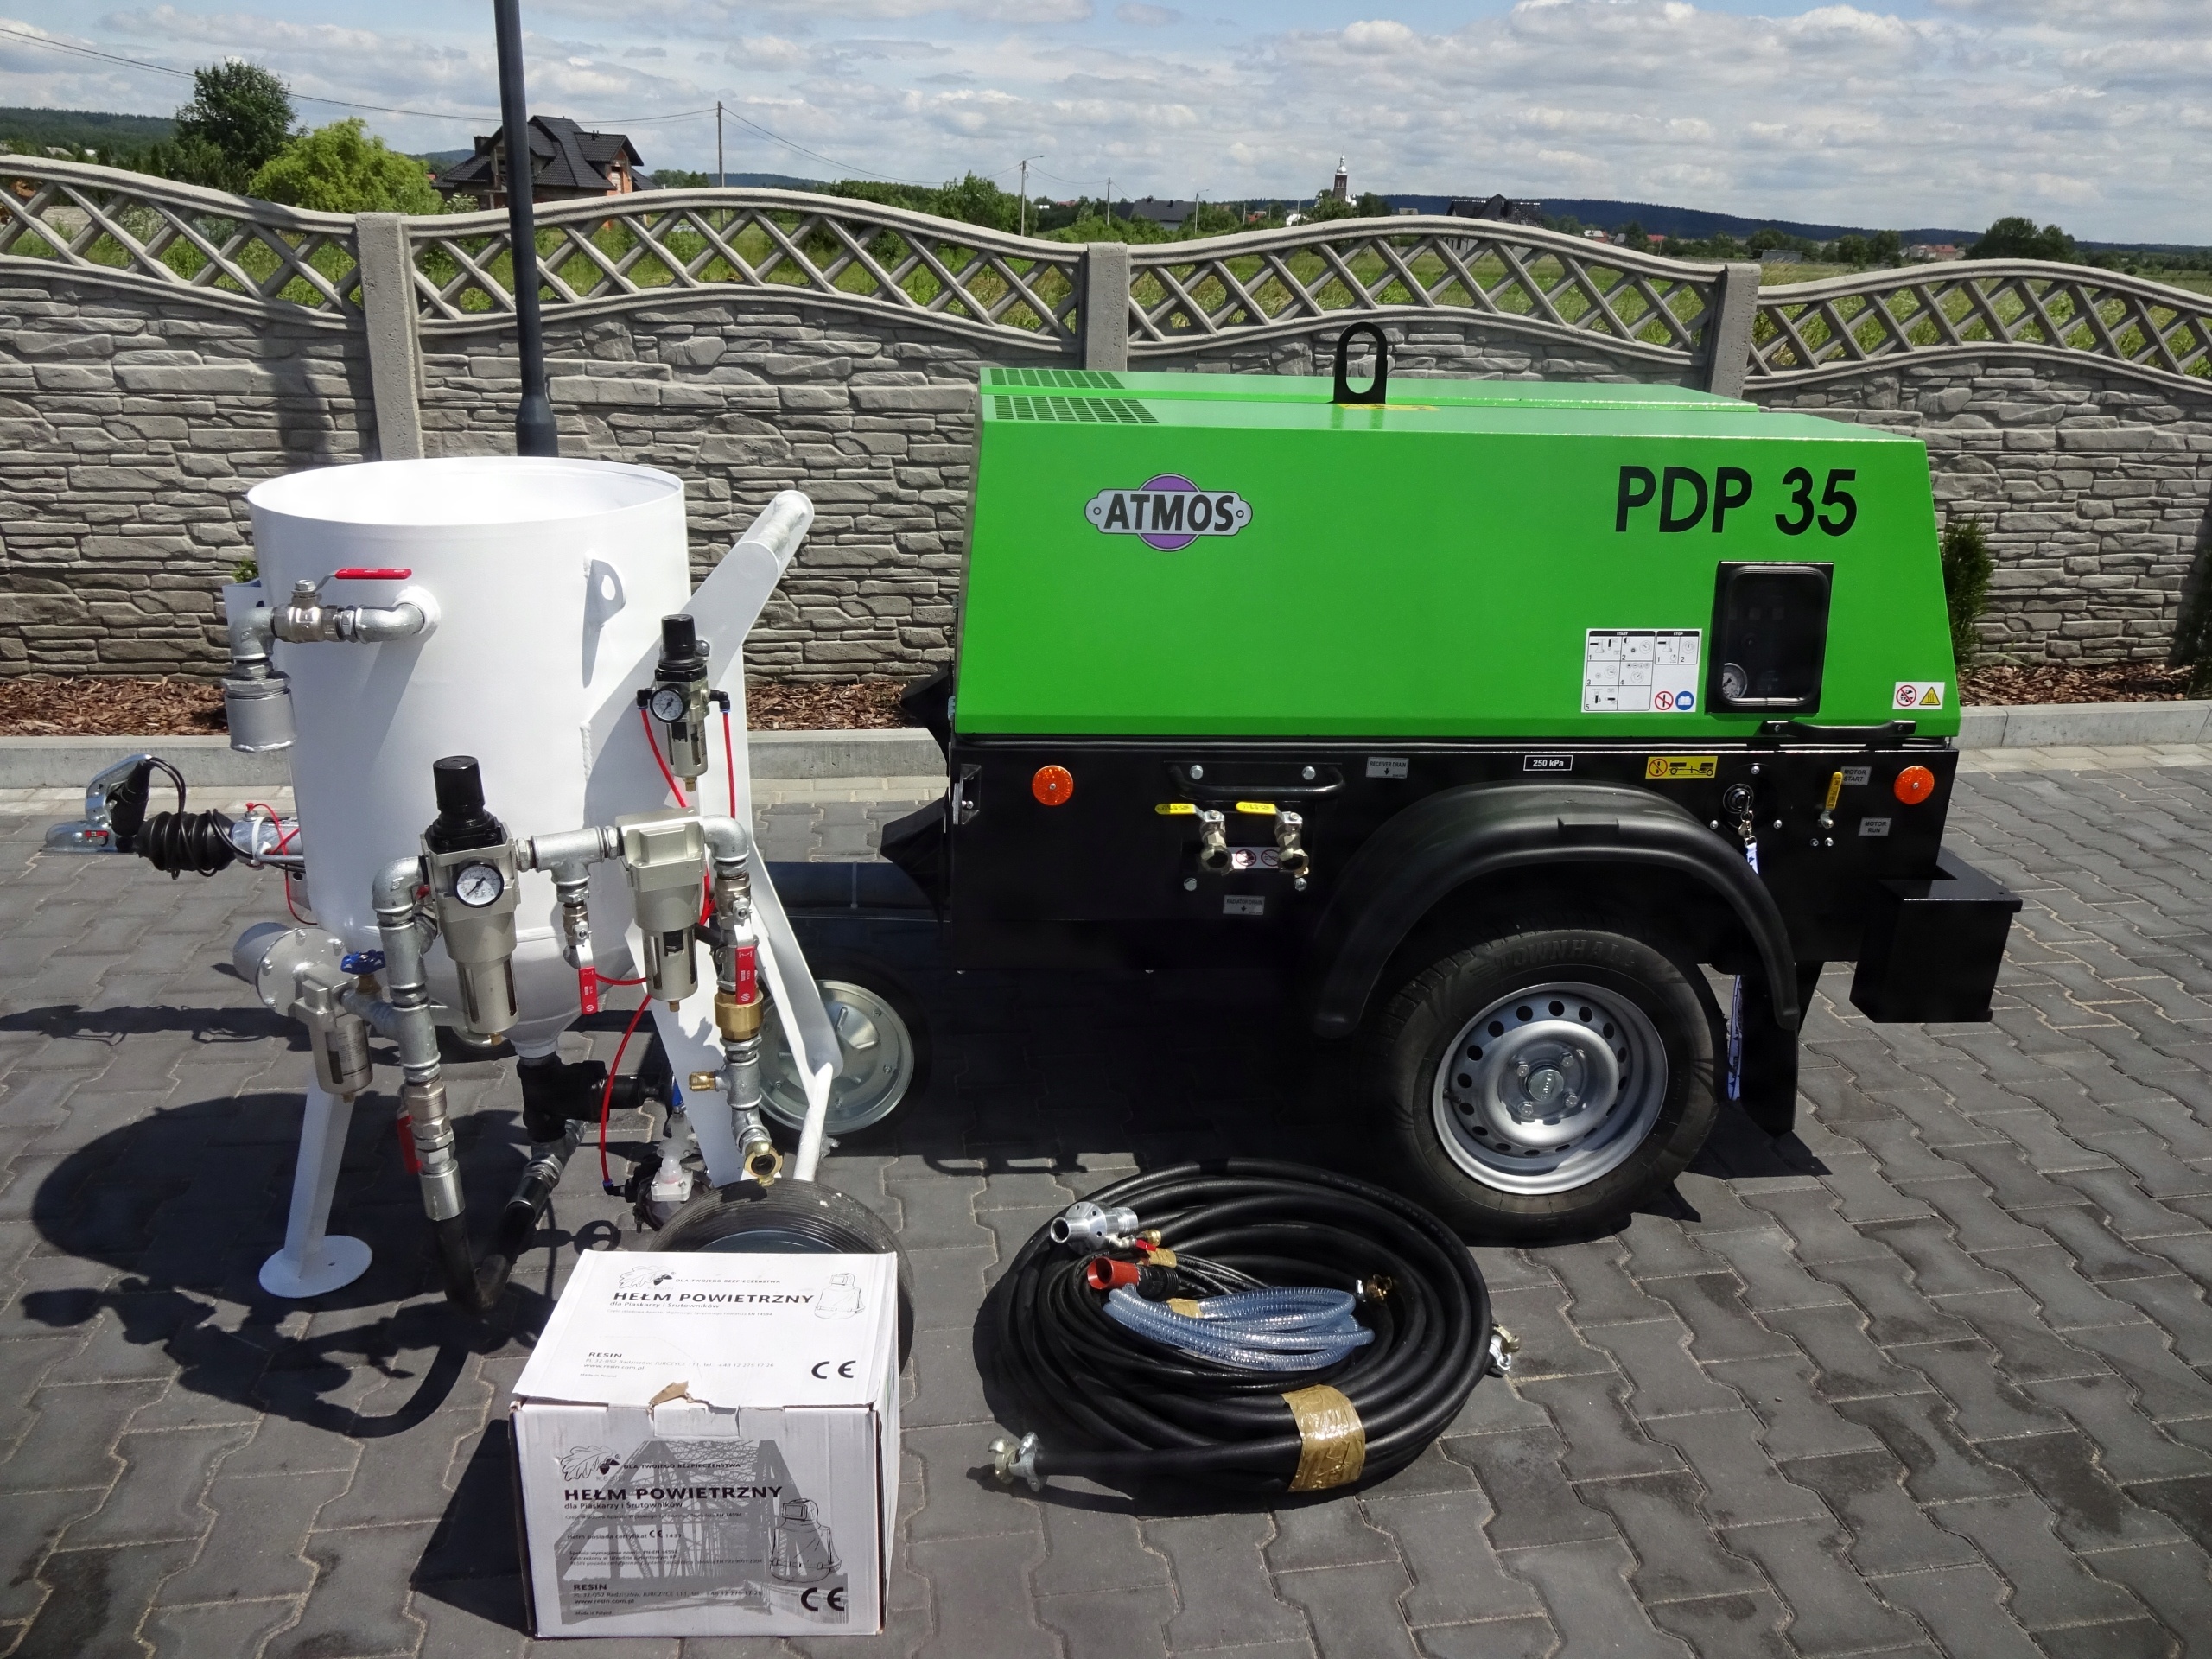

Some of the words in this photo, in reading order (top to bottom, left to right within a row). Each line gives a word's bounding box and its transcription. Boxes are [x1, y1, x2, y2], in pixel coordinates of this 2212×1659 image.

[1615, 466, 1753, 533] PDP
[1774, 467, 1858, 537] 35
[1103, 493, 1235, 532] ATMOS
[1532, 759, 1548, 767] 250
[1549, 759, 1564, 767] kPa
[613, 1292, 672, 1301] HEŁM
[679, 1294, 815, 1304] POWIETRZNY
[564, 1488, 626, 1501] HEŁM
[636, 1486, 783, 1500] POWIETRZNY
